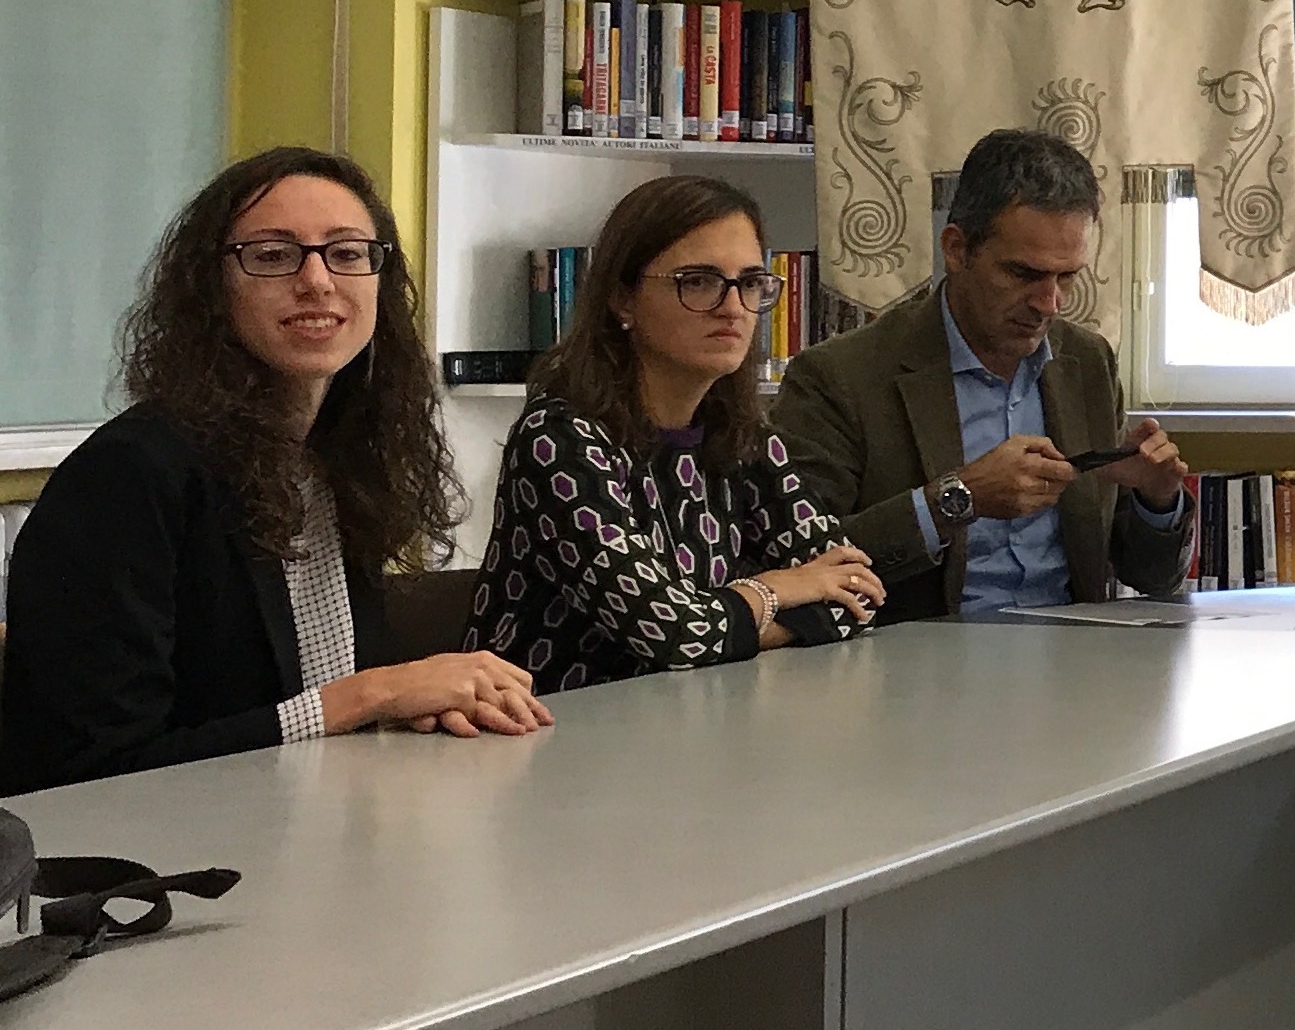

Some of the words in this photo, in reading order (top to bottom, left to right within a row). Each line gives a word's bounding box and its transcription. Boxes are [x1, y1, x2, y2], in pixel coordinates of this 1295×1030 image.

[704, 55, 717, 86] CASTA
[522, 137, 557, 146] ULTIME
[602, 139, 636, 148] AUTORI
[639, 141, 680, 150] ITALIANI
